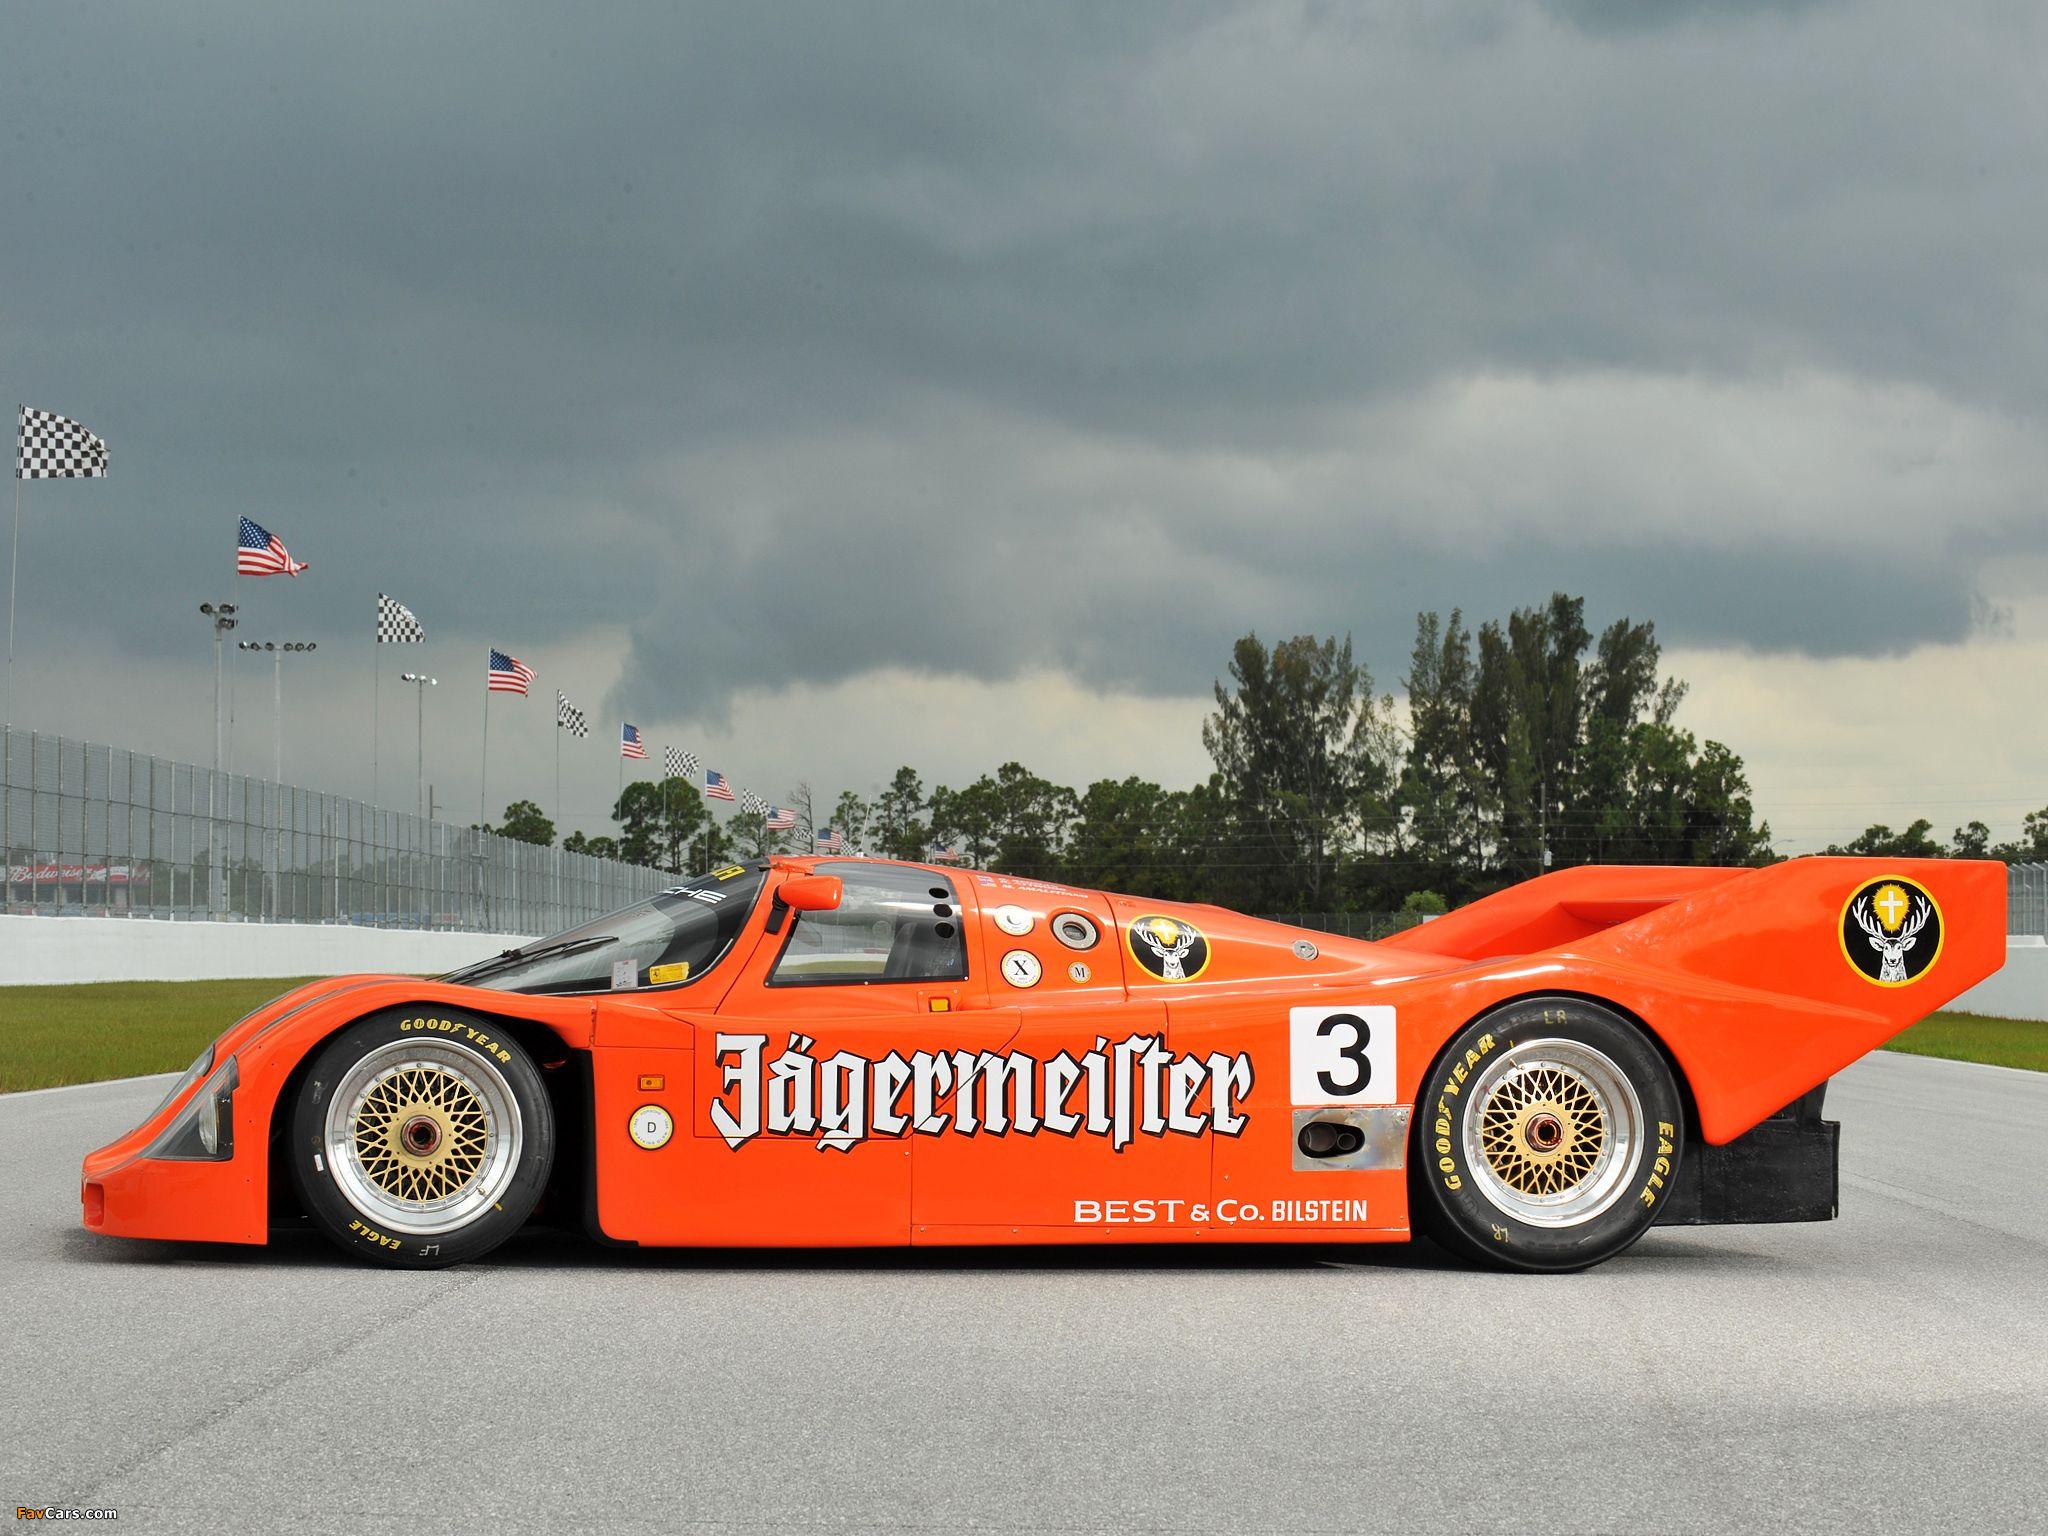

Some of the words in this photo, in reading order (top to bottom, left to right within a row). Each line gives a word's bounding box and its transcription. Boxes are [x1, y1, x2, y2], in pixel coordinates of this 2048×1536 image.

[1013, 960, 1029, 976] X
[1074, 966, 1085, 978] M
[400, 1018, 512, 1064] GOODYEAR
[1316, 1013, 1372, 1097] 3
[709, 1031, 1257, 1154] Jägermeister
[647, 1121, 656, 1133] D
[1435, 1033, 1496, 1191] GOODYEAR
[1639, 1121, 1674, 1208] EAGLE
[1073, 1199, 1185, 1223] BEST
[1189, 1203, 1210, 1222] &
[1216, 1199, 1265, 1223] Co.
[1271, 1199, 1368, 1222] BILSTEIN
[348, 1219, 402, 1250] EAGLE
